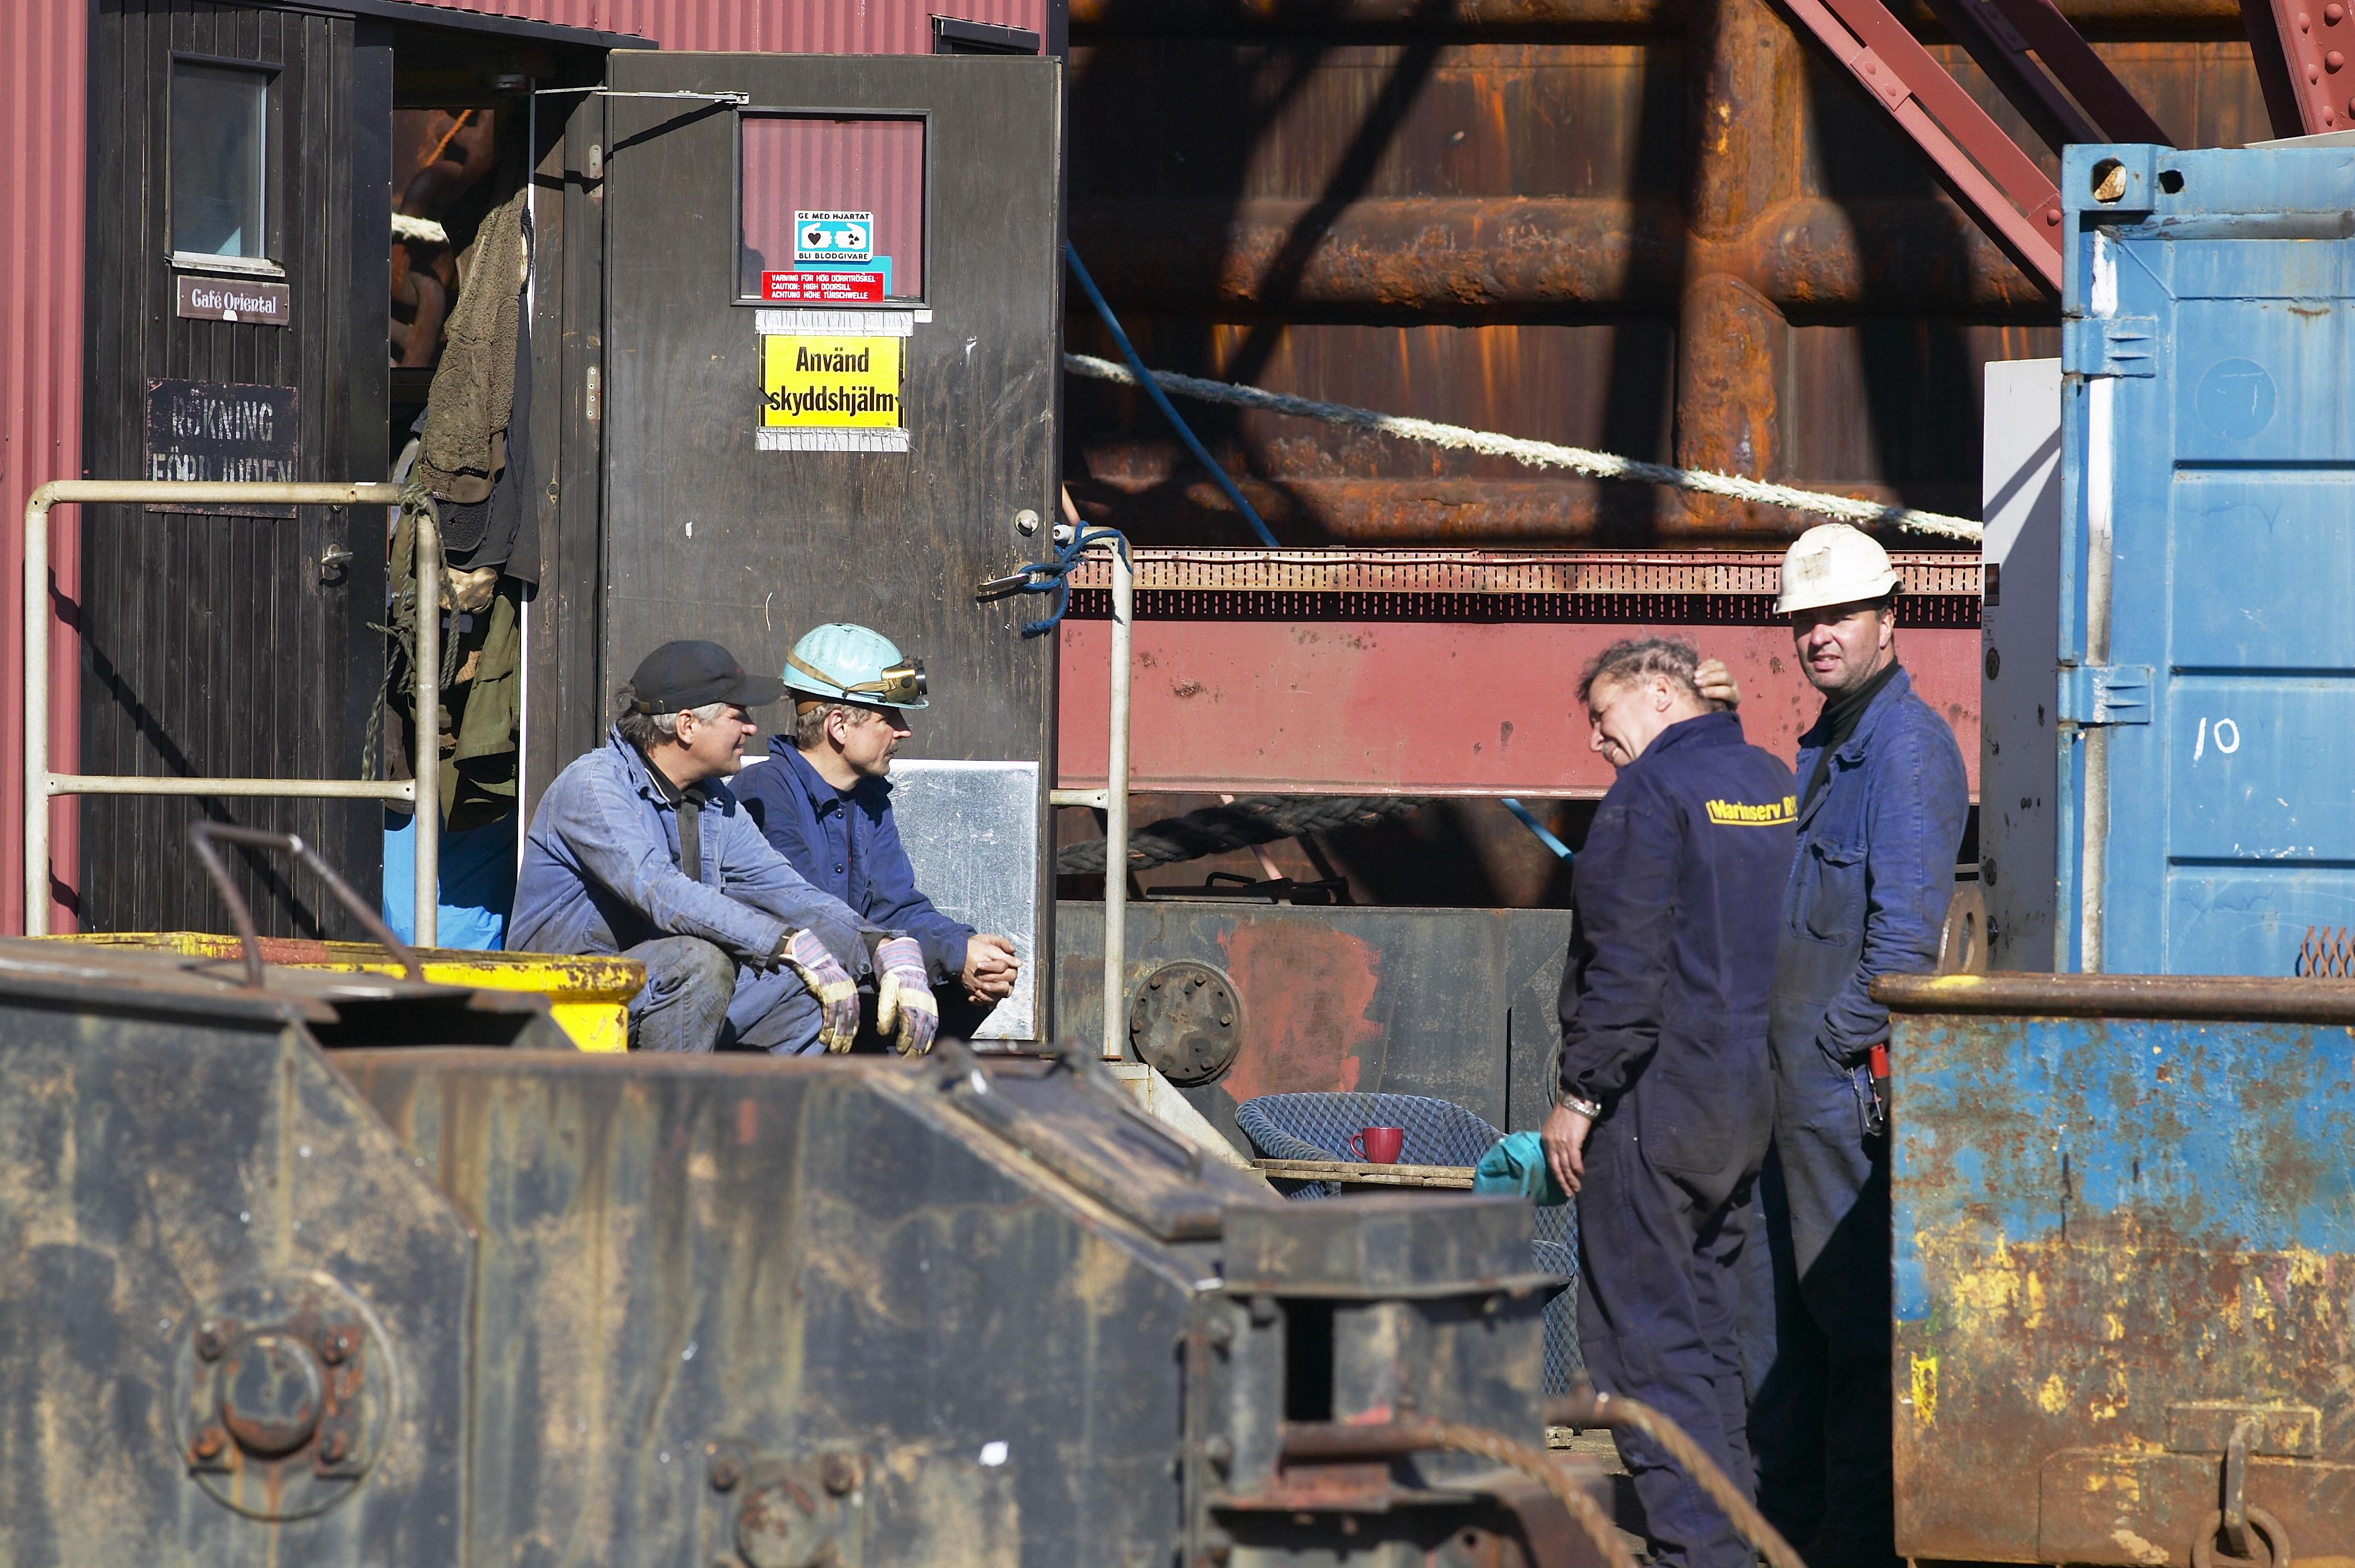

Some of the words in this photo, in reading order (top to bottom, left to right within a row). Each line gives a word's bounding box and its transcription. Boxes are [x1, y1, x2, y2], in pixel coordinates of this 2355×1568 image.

[816, 274, 829, 282] HÖG
[191, 289, 222, 309] Café
[224, 292, 277, 313] Oriental
[824, 291, 868, 299] TÜRSCHWELLE
[796, 346, 869, 372] Använd
[770, 385, 894, 417] skyddshjälm
[2194, 717, 2240, 761] 10
